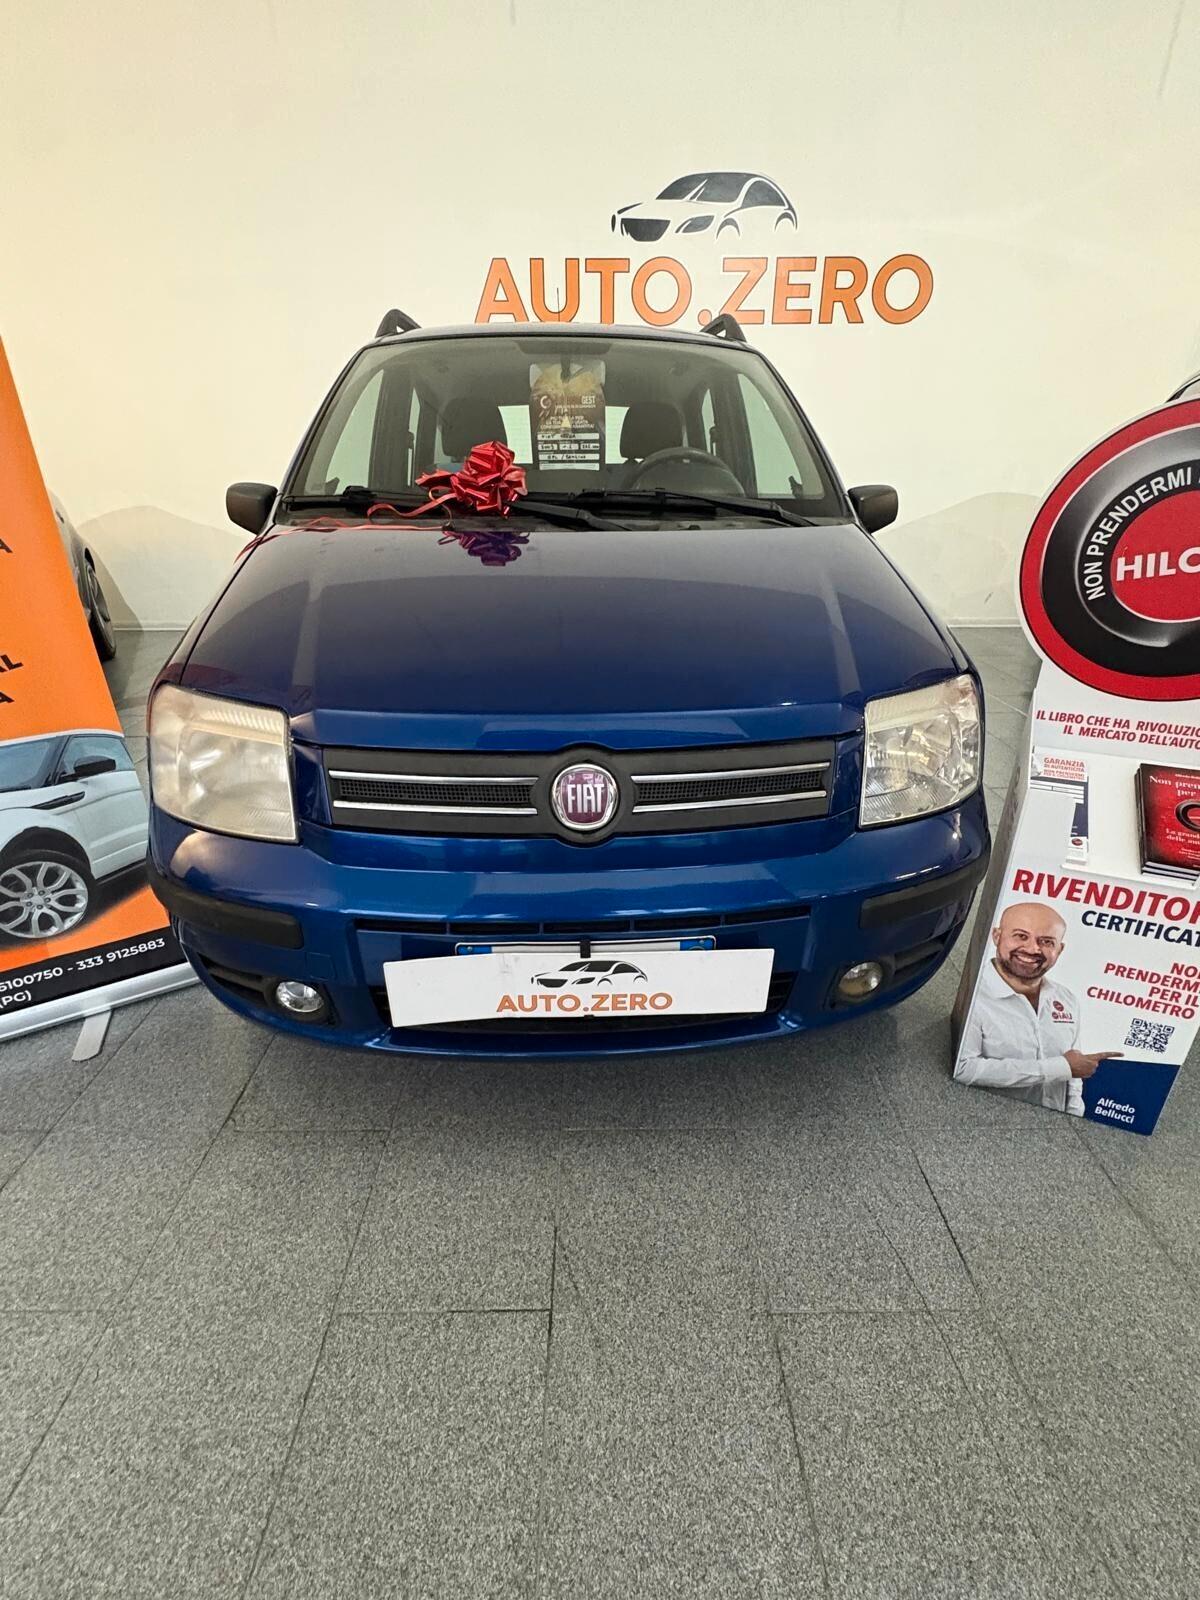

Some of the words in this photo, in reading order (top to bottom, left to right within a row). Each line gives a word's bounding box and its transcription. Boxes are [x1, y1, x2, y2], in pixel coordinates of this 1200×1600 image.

[474, 253, 934, 326] AUTO.ZERO
[1087, 467, 1192, 556] PRENDERMI
[1083, 562, 1106, 601] NON
[1036, 709, 1046, 721] IL
[1050, 711, 1083, 725] LIBRO
[1086, 715, 1110, 728] CHE
[1113, 718, 1130, 730] HA
[1063, 725, 1073, 735] IL
[1079, 726, 1136, 742] MERCATO
[1043, 757, 1085, 768] GARANZIA
[1149, 775, 1172, 786] Non
[567, 783, 605, 814] FIAT
[76, 955, 104, 971] 333
[106, 938, 166, 963] 9125883
[1103, 962, 1200, 993] PRENDERM
[1170, 962, 1200, 979] NO
[496, 992, 674, 1013] AUTO.ZERO
[1086, 986, 1196, 1020] CHILOMETRO
[1148, 986, 1182, 1004] PER
[1184, 994, 1199, 1008] IL
[1094, 1106, 1135, 1125] Bellucci
[1097, 1097, 1136, 1114] Alfredo
